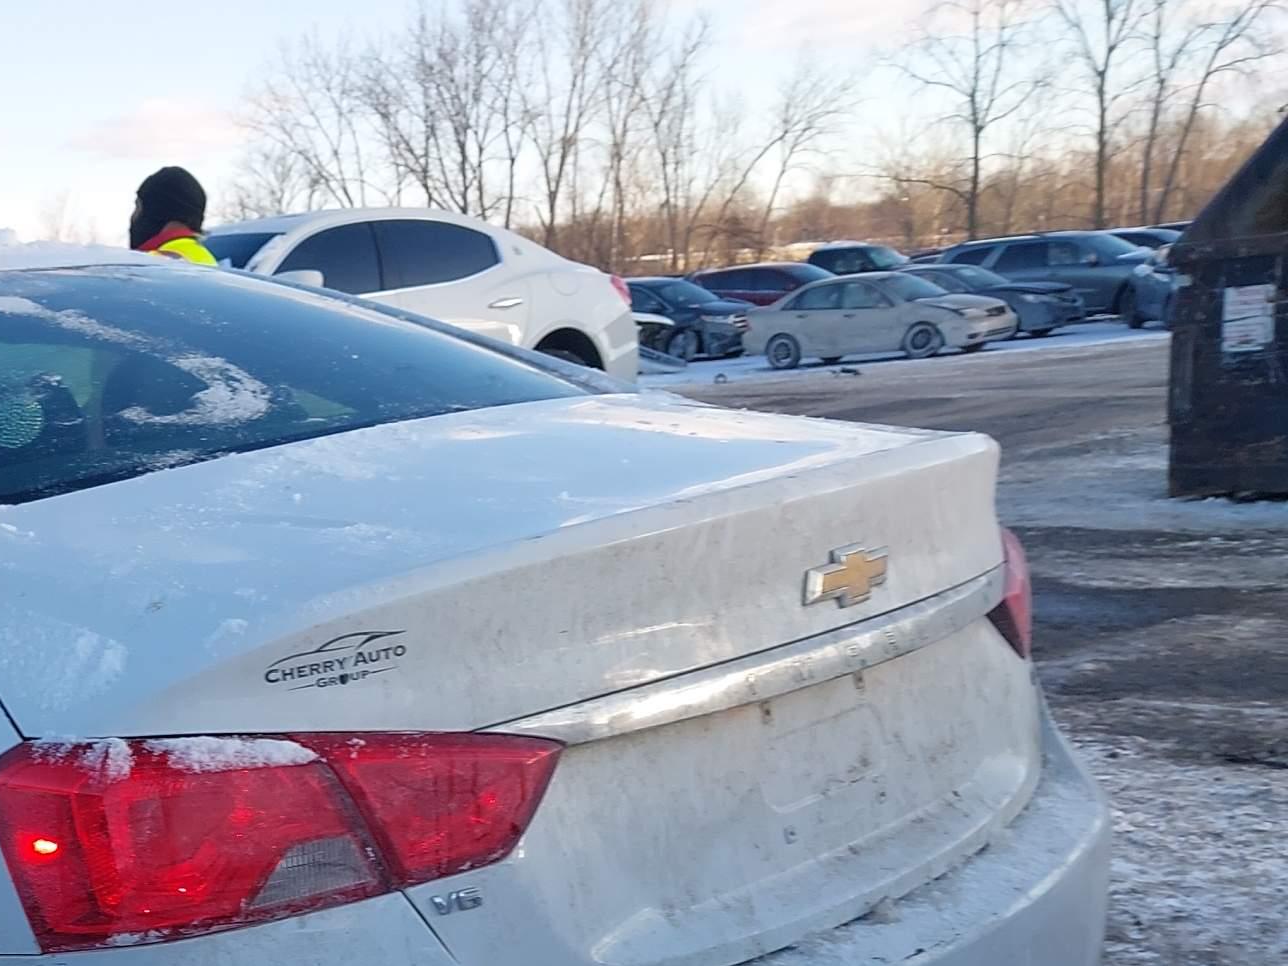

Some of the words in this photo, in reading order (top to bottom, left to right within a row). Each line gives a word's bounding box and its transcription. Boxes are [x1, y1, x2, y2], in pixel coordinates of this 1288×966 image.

[264, 656, 348, 683] CHERRY
[352, 645, 407, 667] AUTO
[430, 887, 483, 915] V6
